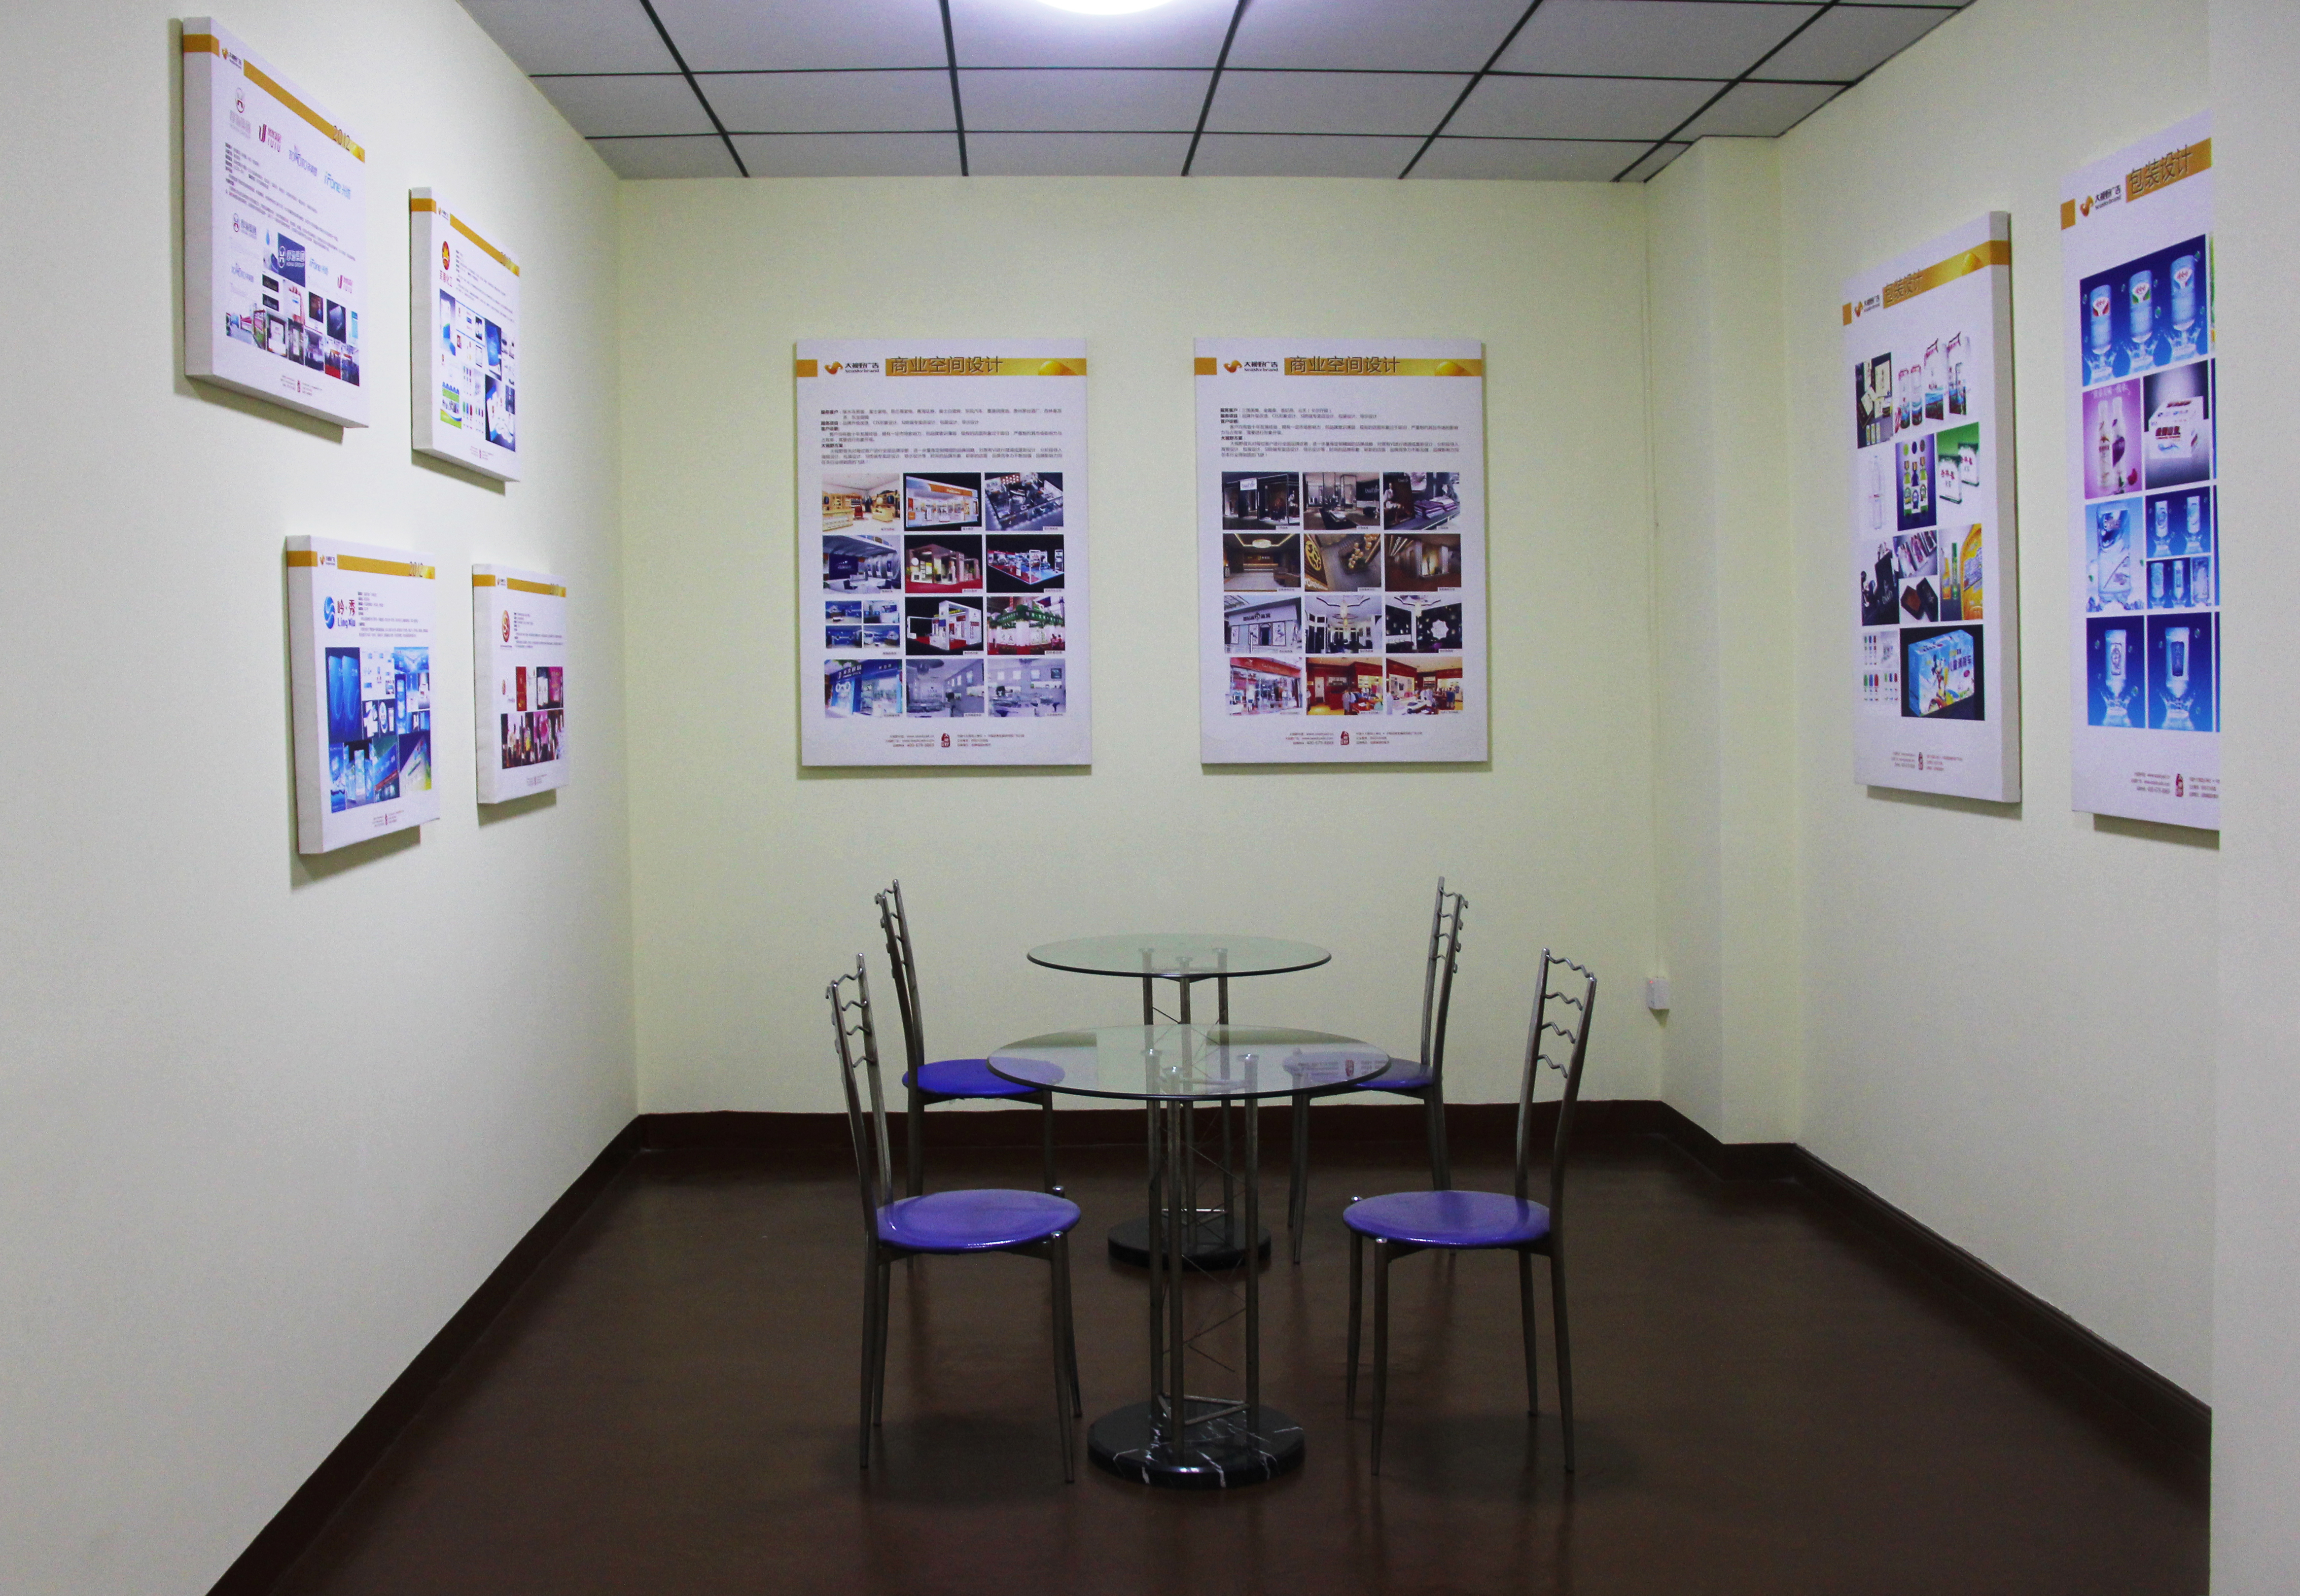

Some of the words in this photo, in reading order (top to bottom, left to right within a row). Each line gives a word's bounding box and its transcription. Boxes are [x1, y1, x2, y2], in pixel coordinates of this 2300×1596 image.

[2129, 144, 2193, 194] 包装设计
[1885, 269, 1923, 305] 包装设计
[891, 355, 1003, 375] 商业空间设计
[1290, 355, 1400, 374] 商业空间设计
